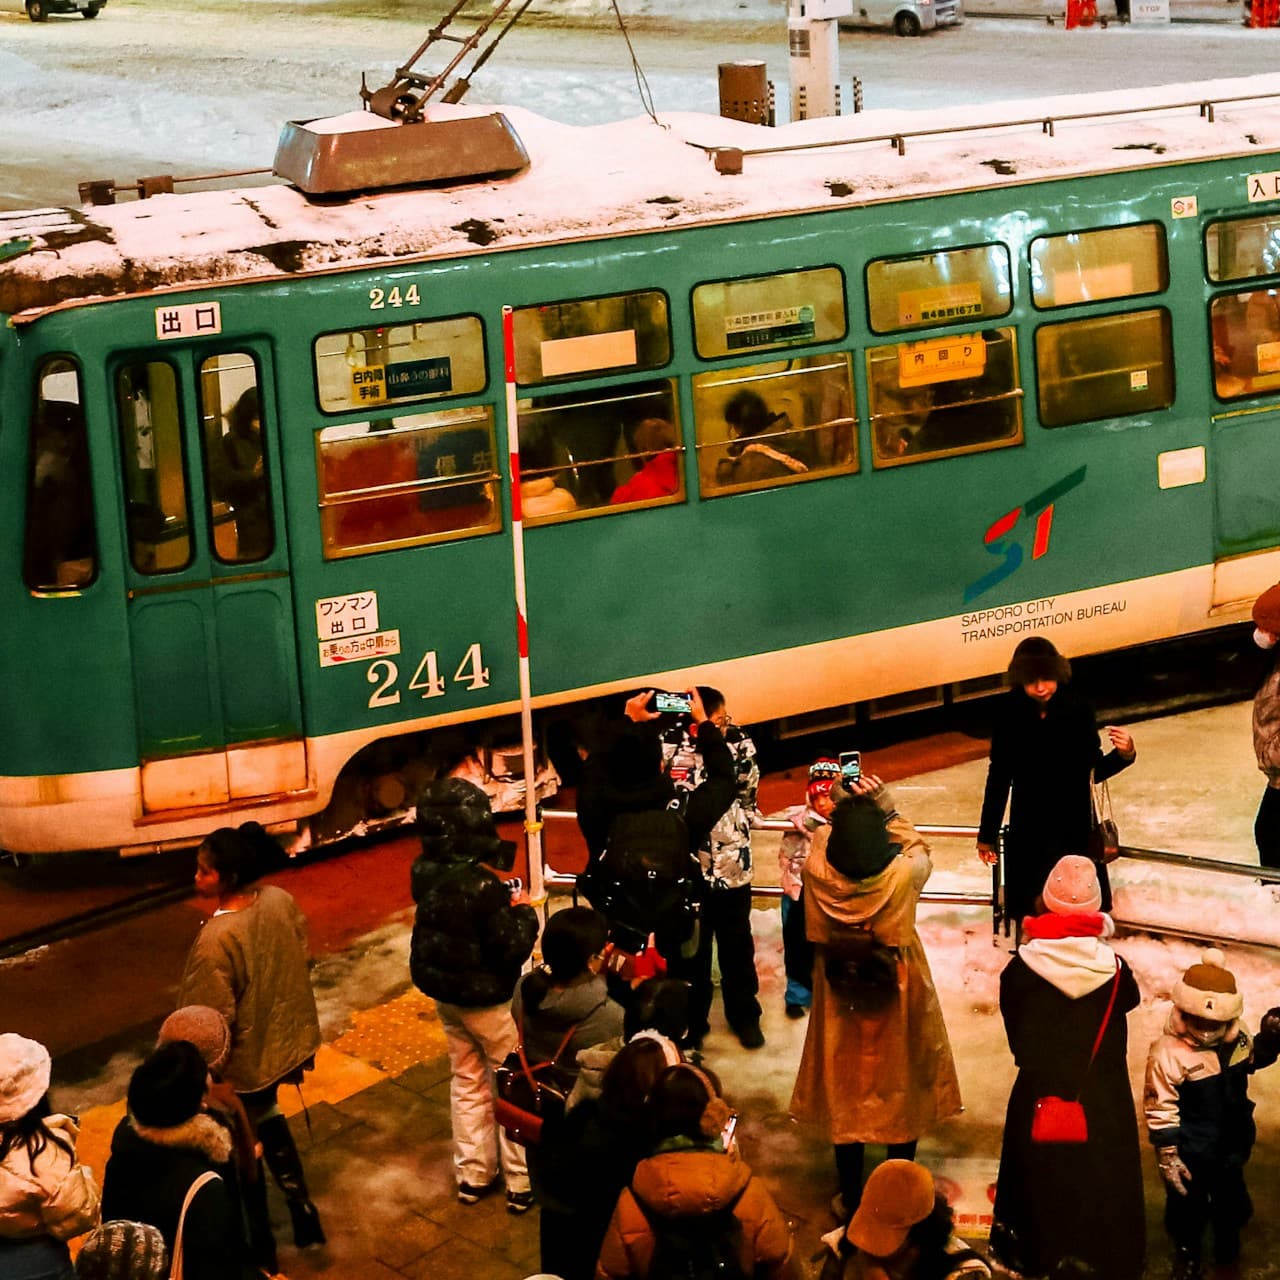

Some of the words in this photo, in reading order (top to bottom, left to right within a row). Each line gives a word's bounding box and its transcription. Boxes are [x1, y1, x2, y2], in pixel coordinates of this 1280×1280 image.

[369, 284, 421, 310] 244
[162, 306, 216, 334] 出口
[914, 346, 972, 365] 内回り
[353, 368, 384, 384] 白内障
[360, 385, 380, 399] 手術
[320, 596, 373, 616] ワンマン
[962, 605, 1022, 627] SAPPORO
[1027, 598, 1055, 614] CITY
[331, 617, 366, 634] 出口
[962, 611, 1072, 643] TRANSPORTATION
[1077, 600, 1127, 620] BUREAU
[322, 636, 396, 658] お乗りの方は中扉から
[367, 643, 490, 709] 244
